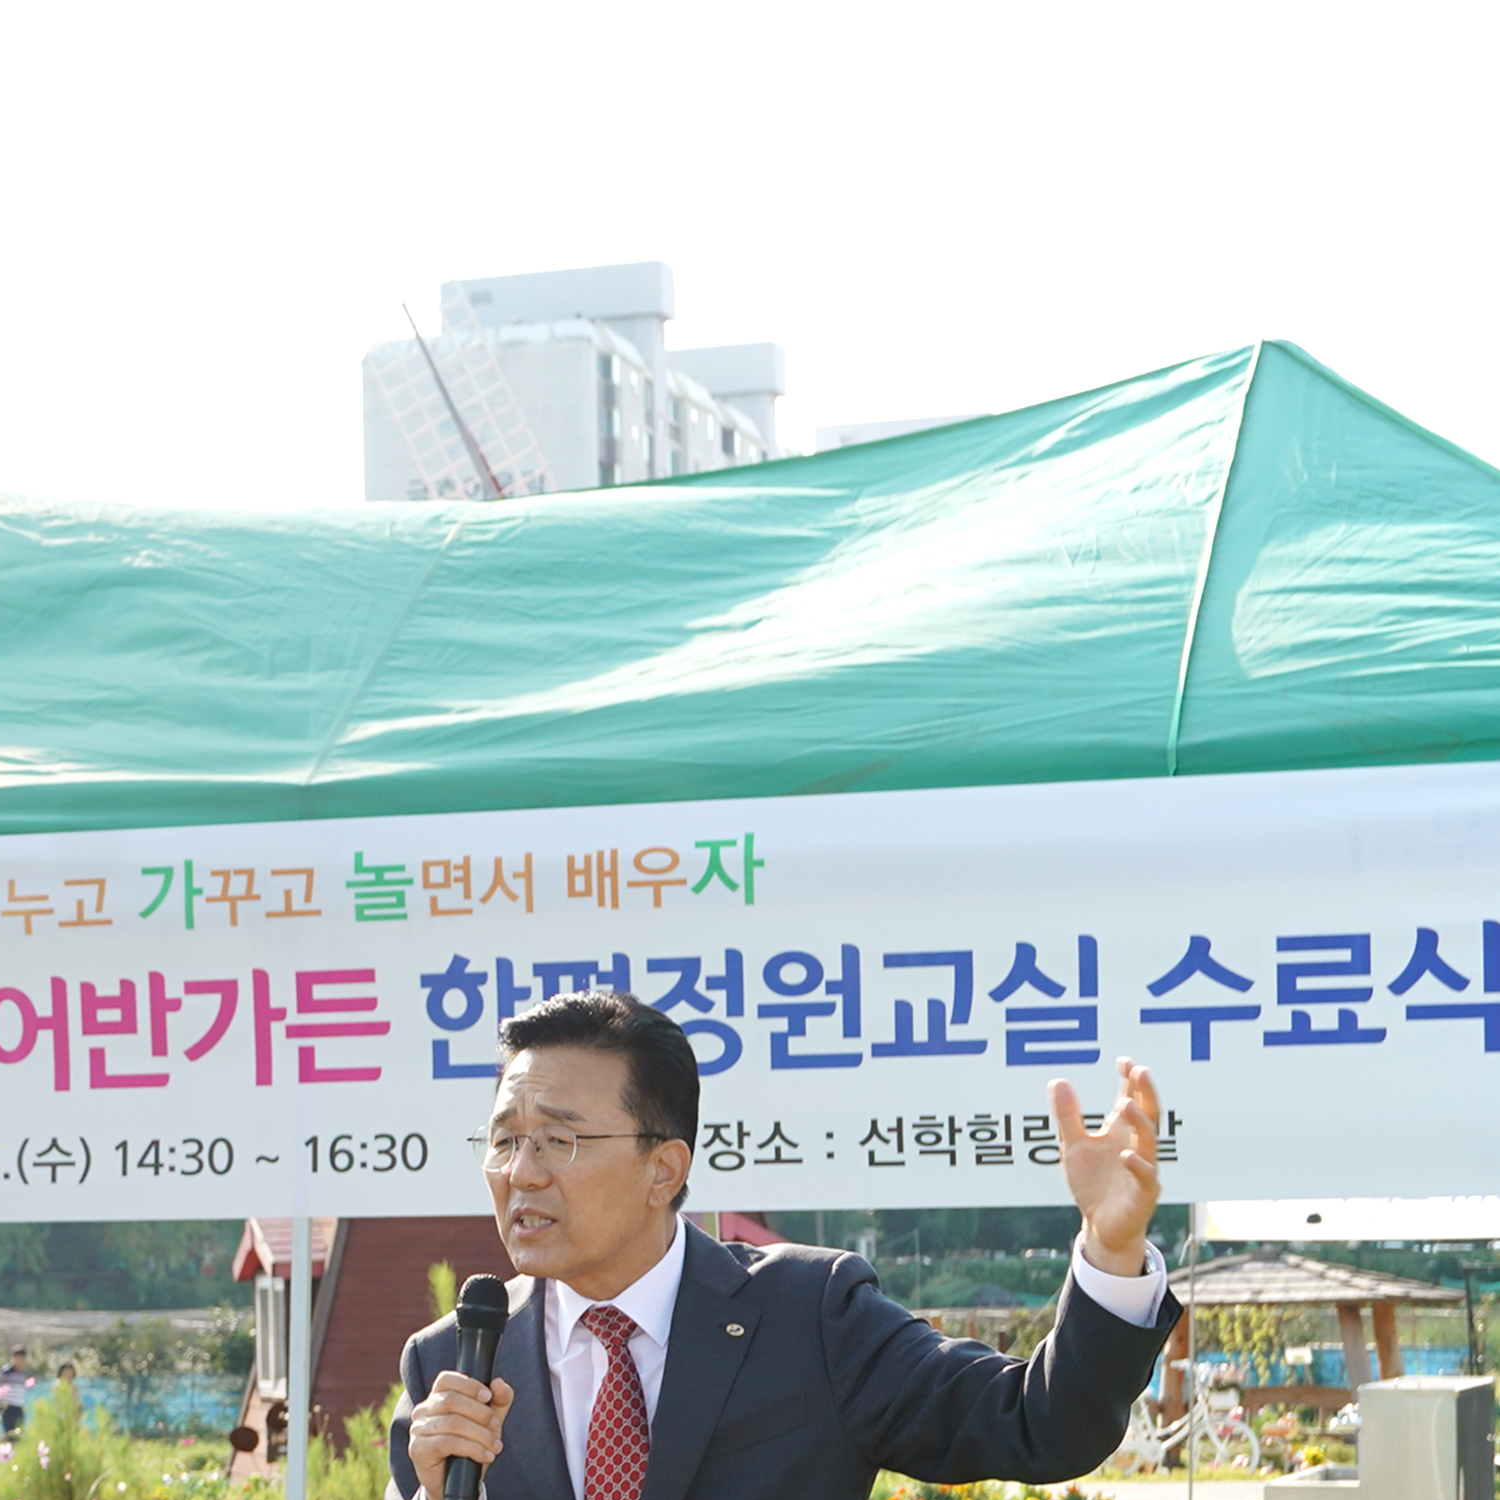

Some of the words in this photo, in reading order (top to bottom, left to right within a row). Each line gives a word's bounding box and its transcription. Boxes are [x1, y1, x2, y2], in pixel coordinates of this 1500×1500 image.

[139, 859, 324, 931] 가꾸고
[345, 850, 535, 924] 놀면서
[567, 832, 766, 911] 배우자
[1138, 918, 1500, 1063] 수료식
[113, 1137, 236, 1178] 14:30
[303, 1132, 430, 1174] 16:30
[701, 1119, 806, 1174] 장소
[859, 1111, 1183, 1169] 선학힐링
